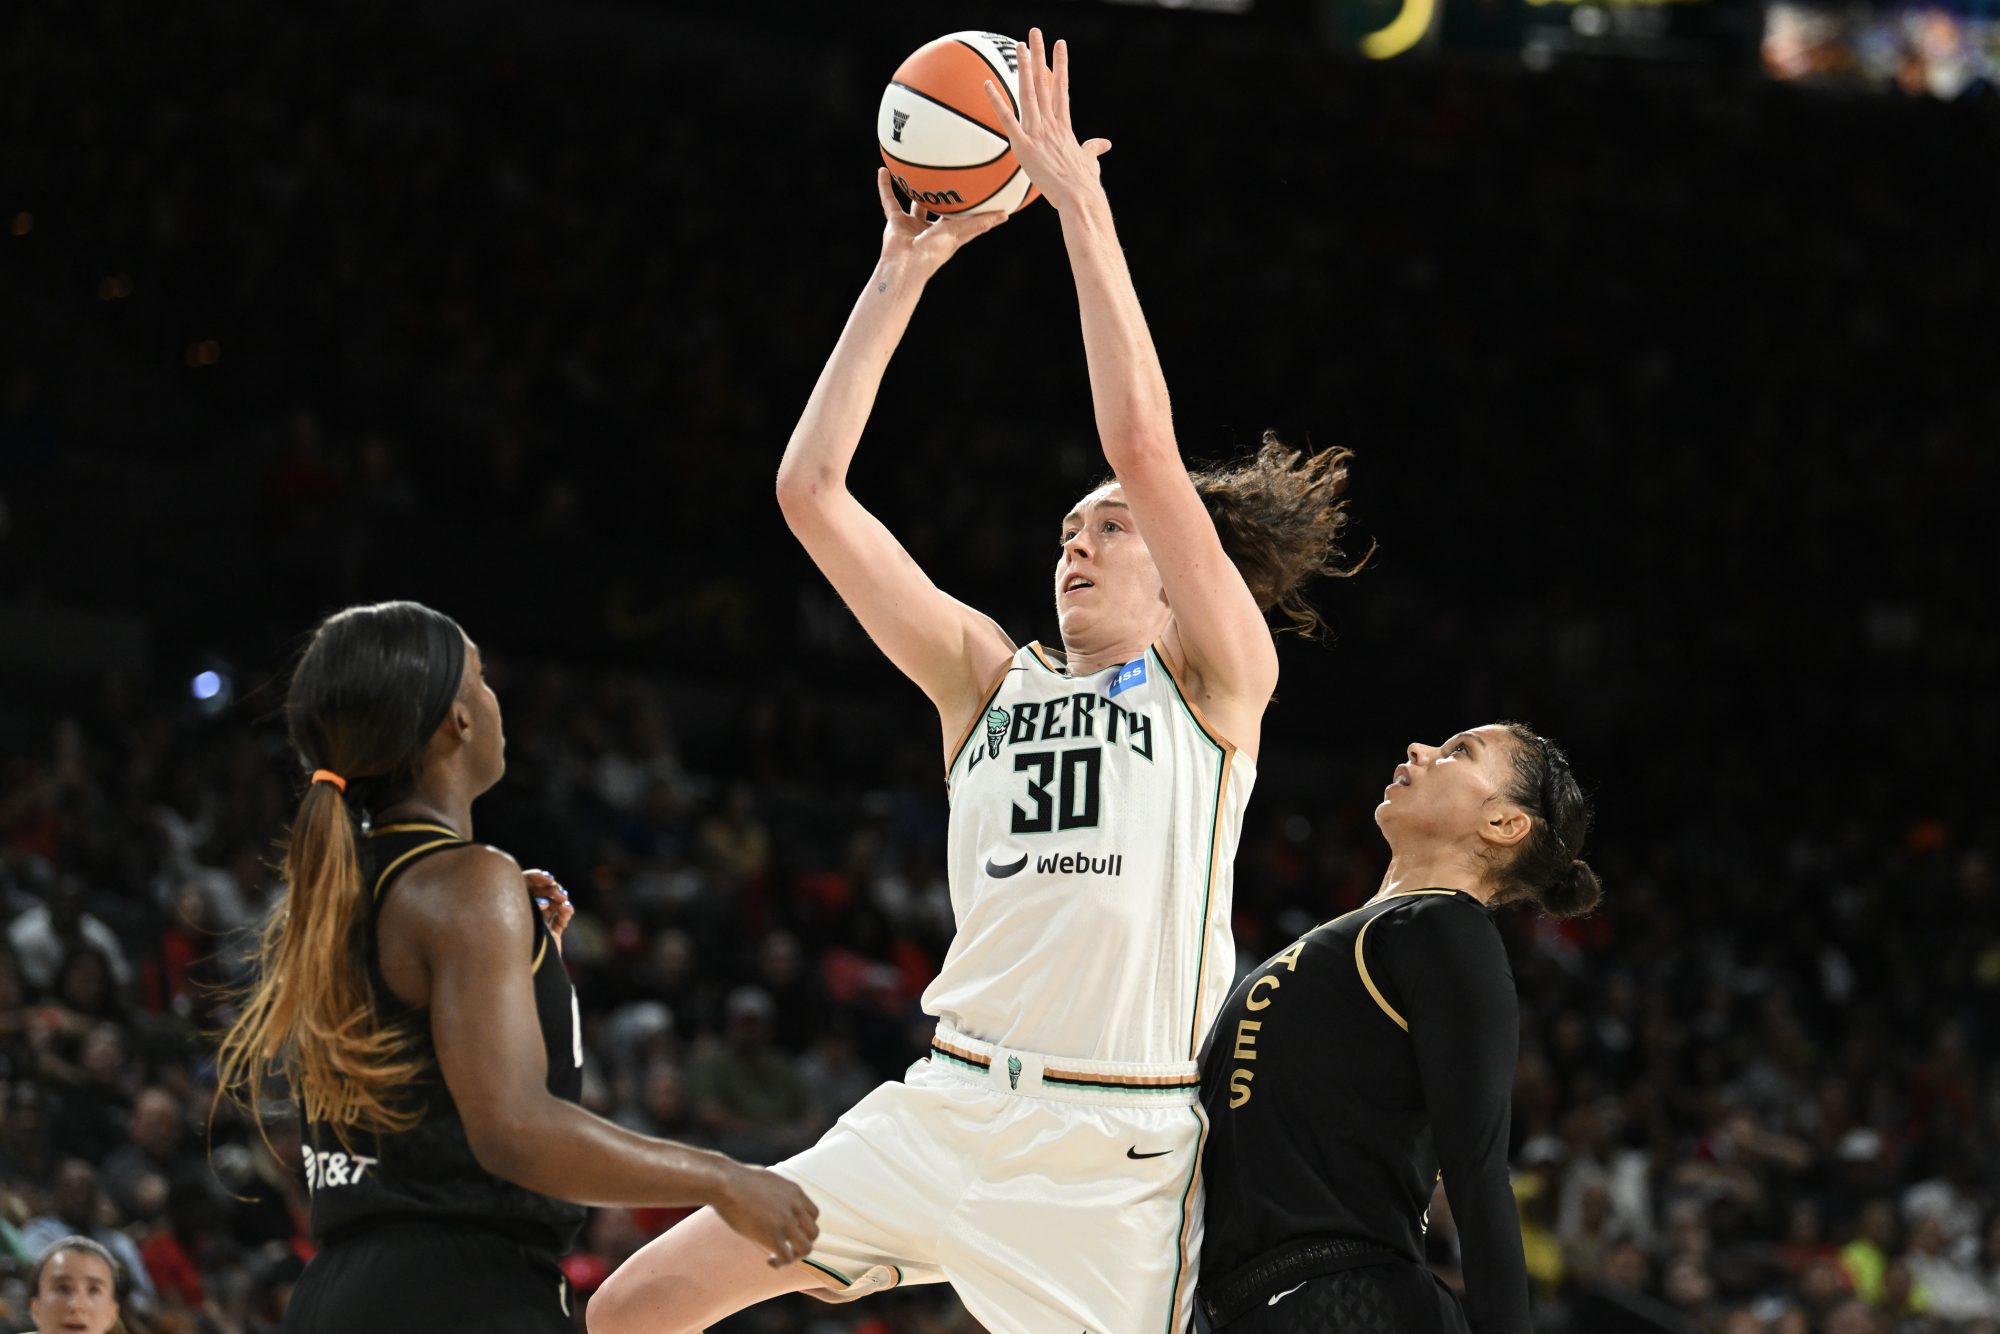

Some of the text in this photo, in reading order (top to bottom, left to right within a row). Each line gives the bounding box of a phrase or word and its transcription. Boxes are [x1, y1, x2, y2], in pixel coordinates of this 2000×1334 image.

[892, 174, 965, 205] lson
[968, 692, 1154, 774] LBERTY
[1010, 747, 1103, 835] 30
[1036, 852, 1122, 876] Webull
[1229, 941, 1307, 1110] ACES
[317, 1152, 378, 1189] T&T
